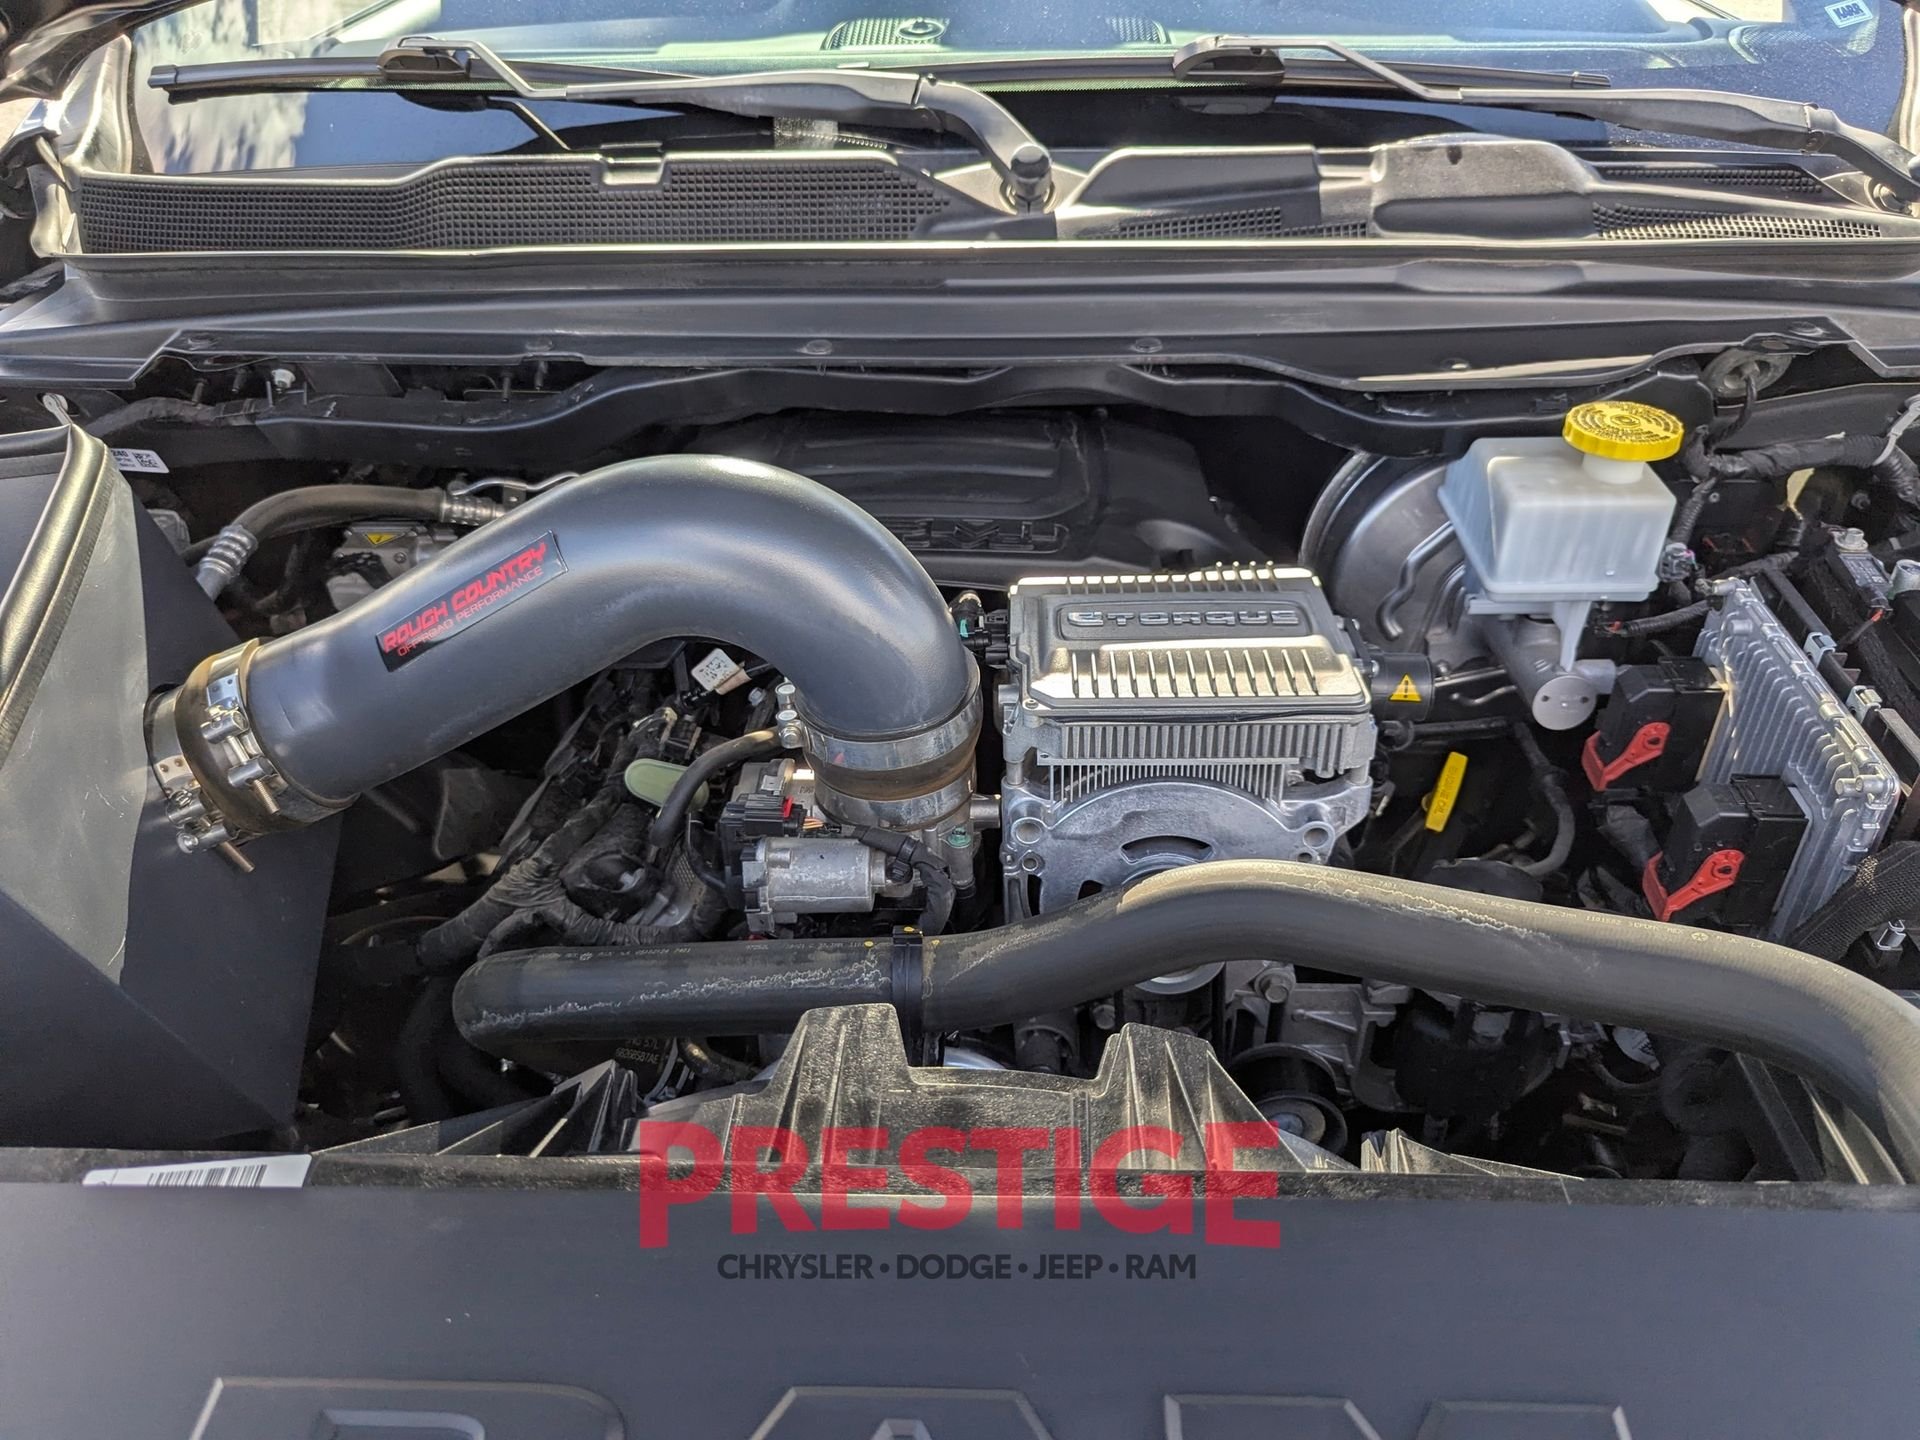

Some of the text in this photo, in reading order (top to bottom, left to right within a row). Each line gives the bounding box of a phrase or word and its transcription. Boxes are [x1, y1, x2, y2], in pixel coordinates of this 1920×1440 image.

[382, 541, 548, 654] ROUGH COUNTRY
[455, 565, 544, 623] PERFORMANCE
